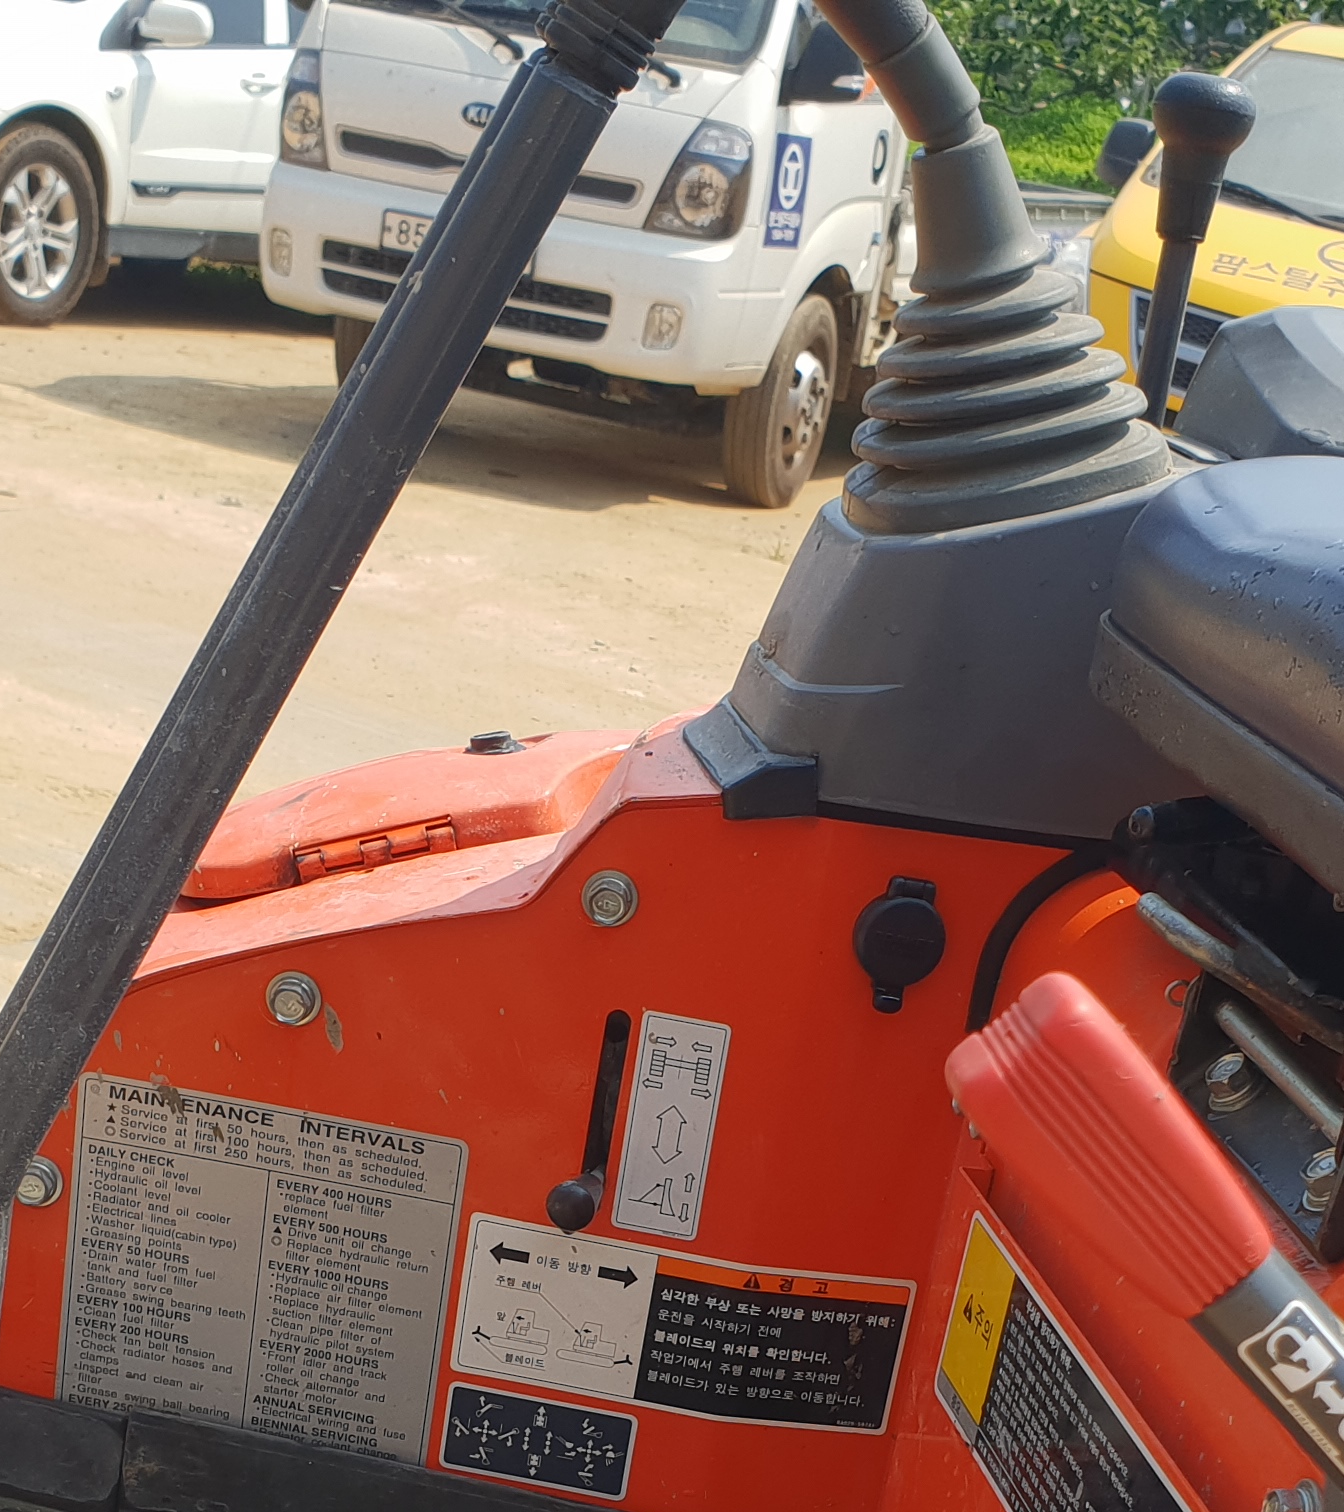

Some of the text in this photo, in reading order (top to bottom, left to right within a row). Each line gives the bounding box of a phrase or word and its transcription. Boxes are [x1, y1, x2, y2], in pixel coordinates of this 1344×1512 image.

[108, 1084, 427, 1155] MAINENANCE INTERVALS
[119, 1116, 428, 1182] Service at first 100 hours, then as scheduled.
[120, 1104, 422, 1169] Service at first 50 hours, then as scheduled.
[88, 1143, 175, 1169] DAILY CHECK
[95, 1155, 189, 1182] Engine oil level
[119, 1127, 426, 1194] Service at first 250 hours, then as scheduled.
[93, 1179, 171, 1202] Coolant level
[94, 1167, 201, 1195] Hydraulic oil level
[276, 1178, 392, 1209] EVERY 400 HOURS
[92, 1190, 231, 1225] Radiator and oil cooler
[92, 1202, 177, 1227] Electrical lines
[272, 1213, 388, 1244] EVERY 500 HOURS
[287, 1227, 412, 1259] Drive unit oil change
[81, 1236, 190, 1265] EVERY 50 HOURS
[286, 1238, 429, 1273] Replace hydraulic return
[537, 1255, 591, 1275] 이동 방향
[267, 1259, 389, 1291] EVERY 1000 HOURS
[76, 1293, 191, 1322] EVERY 100 HOURS
[661, 1288, 896, 1328] 심각한 부상 또는 사망을 방지하기 위해:
[74, 1316, 189, 1345] EVERY 200 HOURS
[658, 1309, 781, 1338] 운전을 시작하기 전에
[975, 1303, 994, 1351] 주의
[259, 1338, 379, 1369] EVERY 2000 HOURS
[267, 1350, 387, 1381] Front idler and track
[252, 1394, 374, 1425] ANNUAL SERVICING
[261, 1405, 406, 1440] Electrical wiring and fuse
[250, 1416, 378, 1448] BIENNIAL SERVICING
